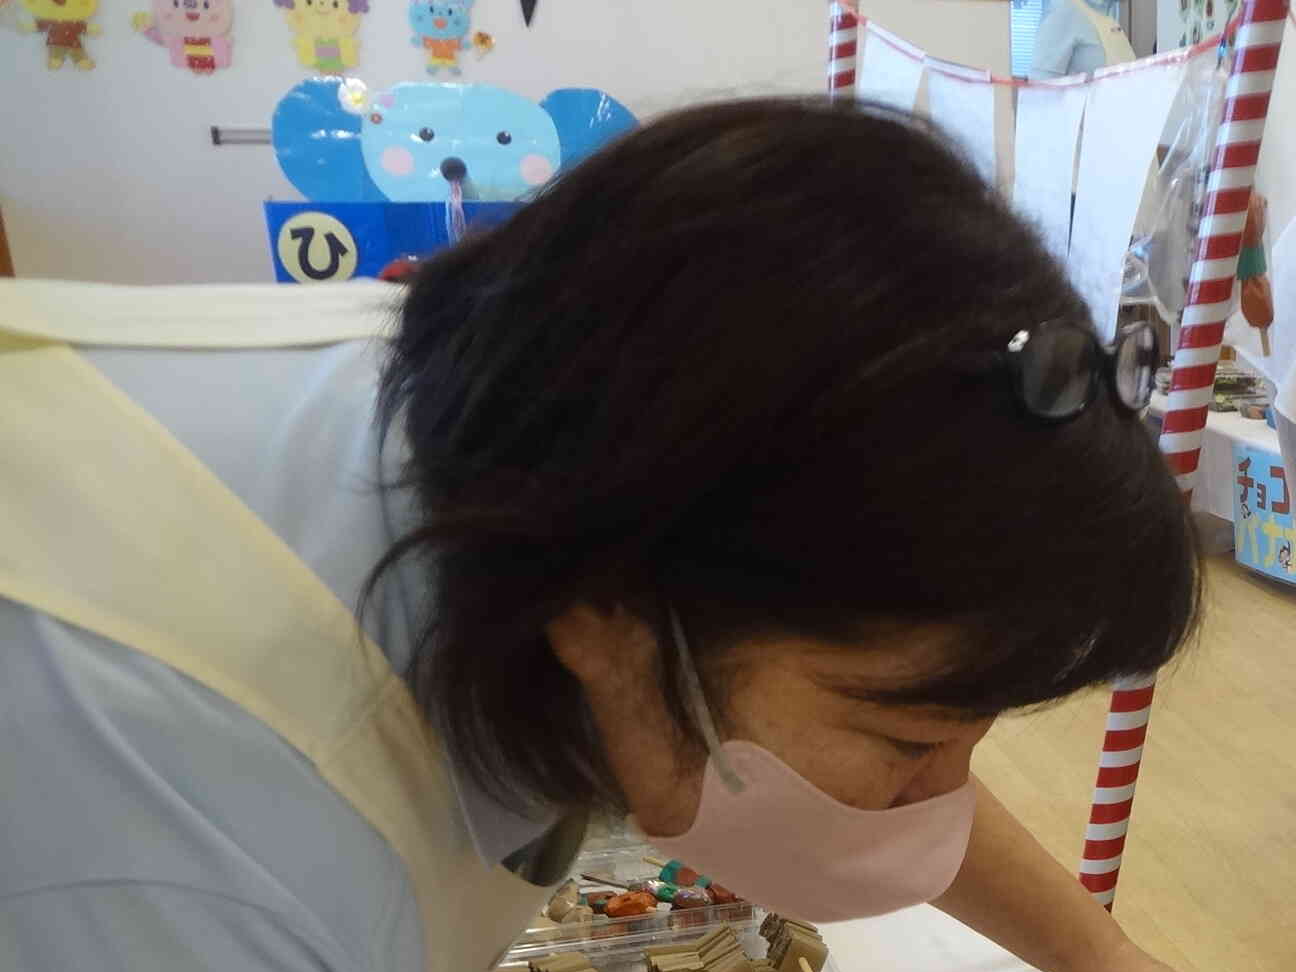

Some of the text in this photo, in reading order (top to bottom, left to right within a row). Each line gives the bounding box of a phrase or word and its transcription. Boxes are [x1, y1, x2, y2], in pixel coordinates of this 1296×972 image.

[290, 227, 349, 281] ひ
[1237, 457, 1290, 515] チョコ
